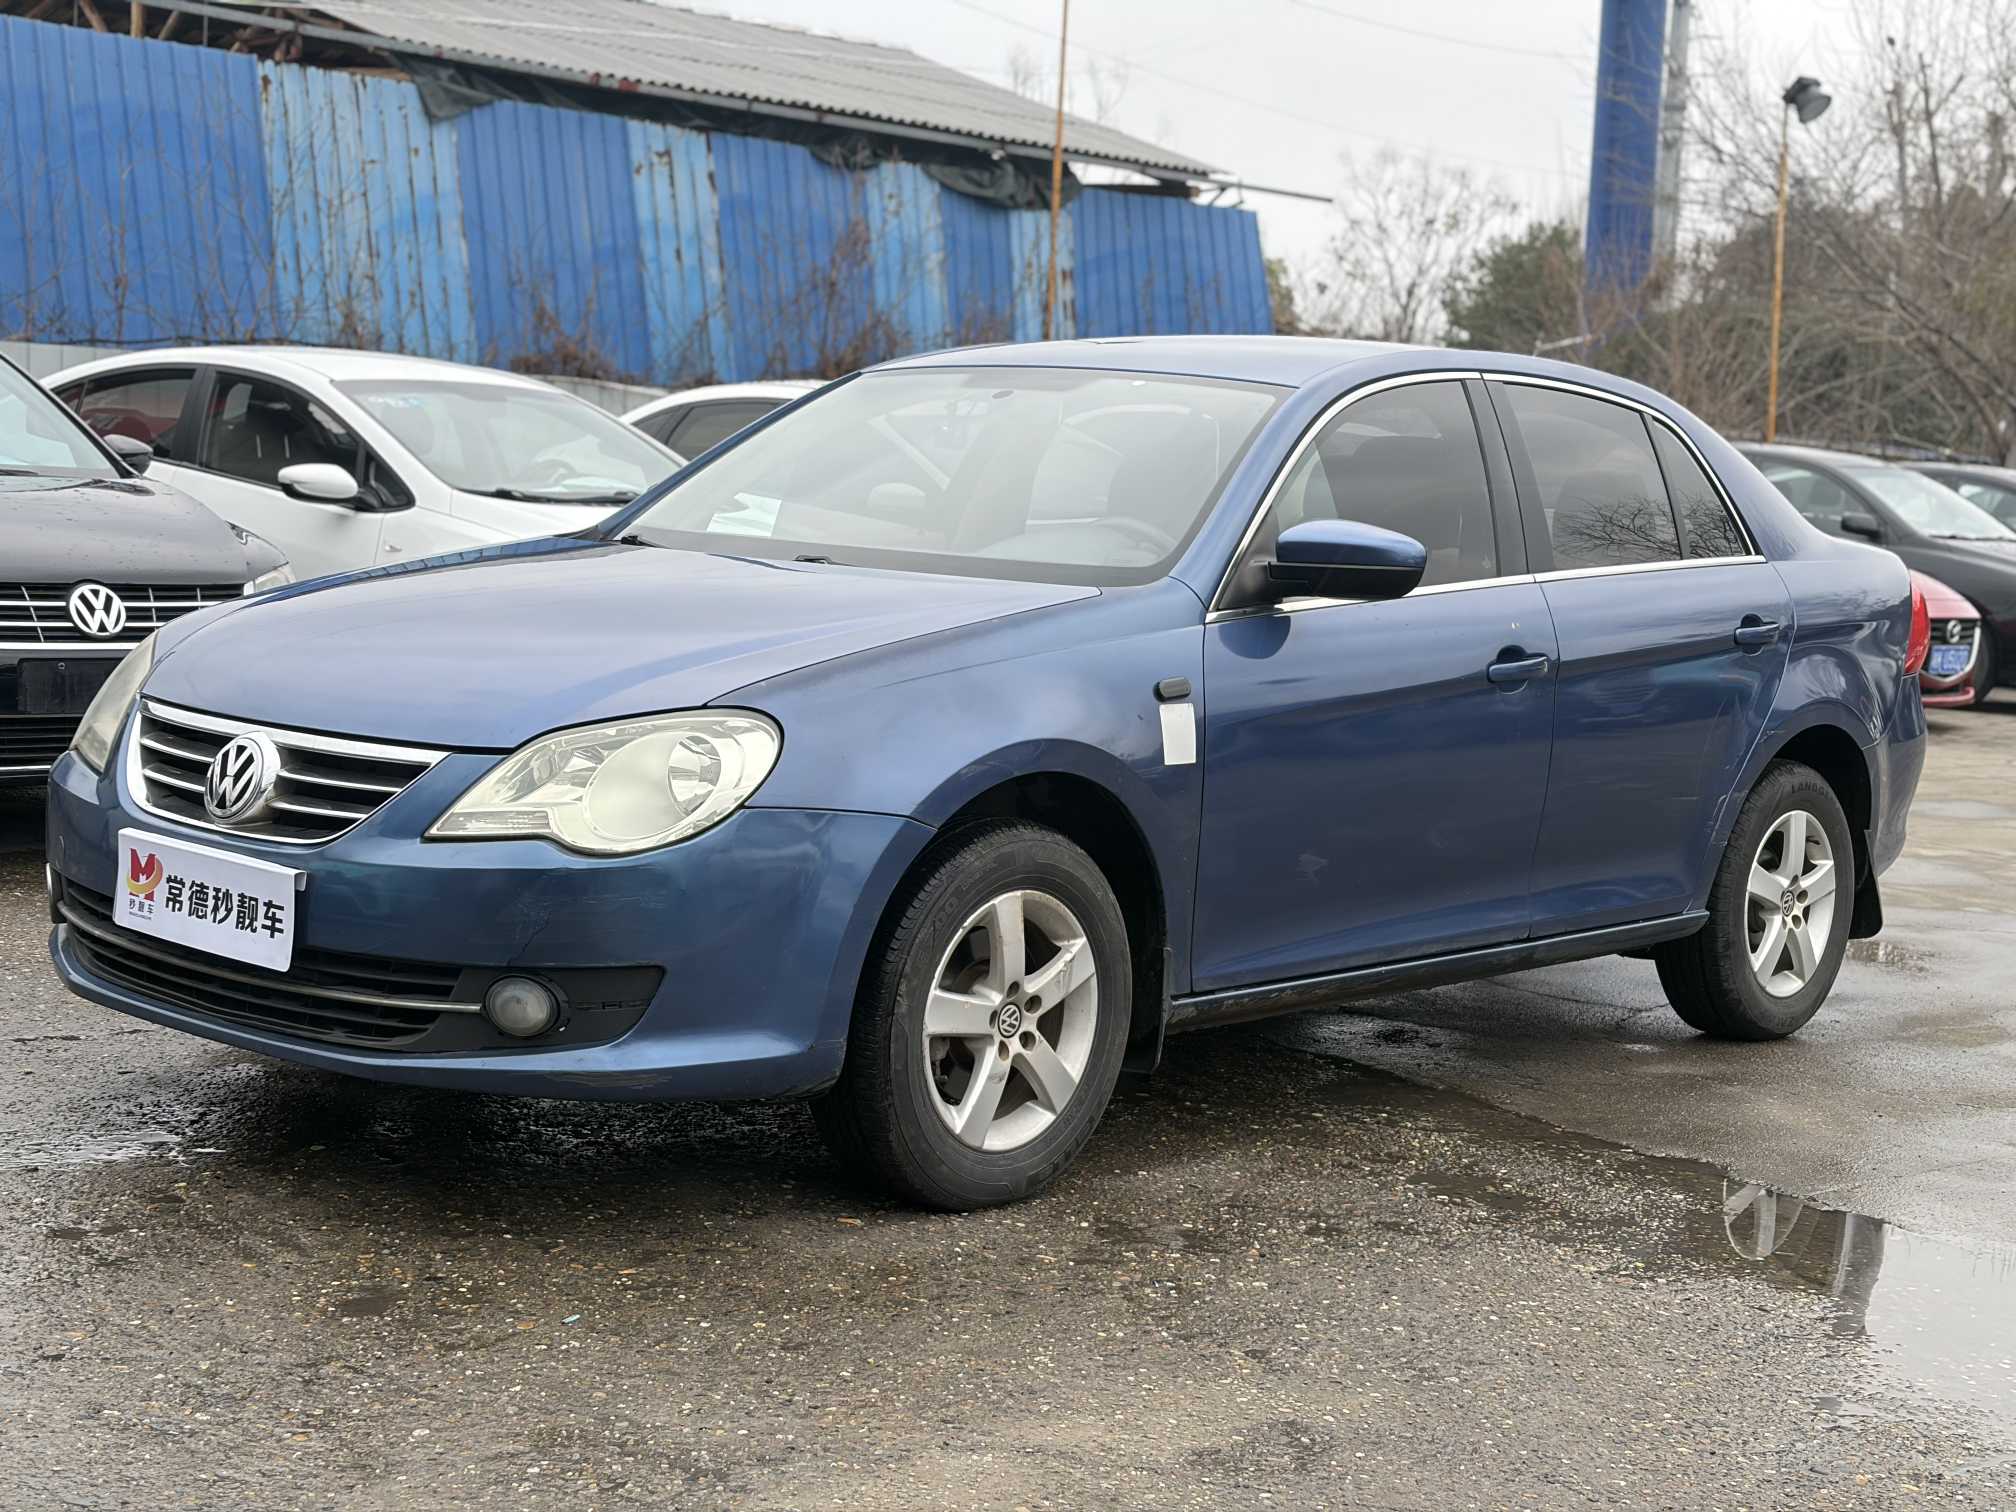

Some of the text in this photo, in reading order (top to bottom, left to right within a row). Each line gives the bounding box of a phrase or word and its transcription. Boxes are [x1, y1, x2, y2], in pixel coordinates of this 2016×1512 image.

[70, 585, 126, 635] VW
[207, 737, 265, 818] VW
[165, 874, 285, 939] 常德秒靓车
